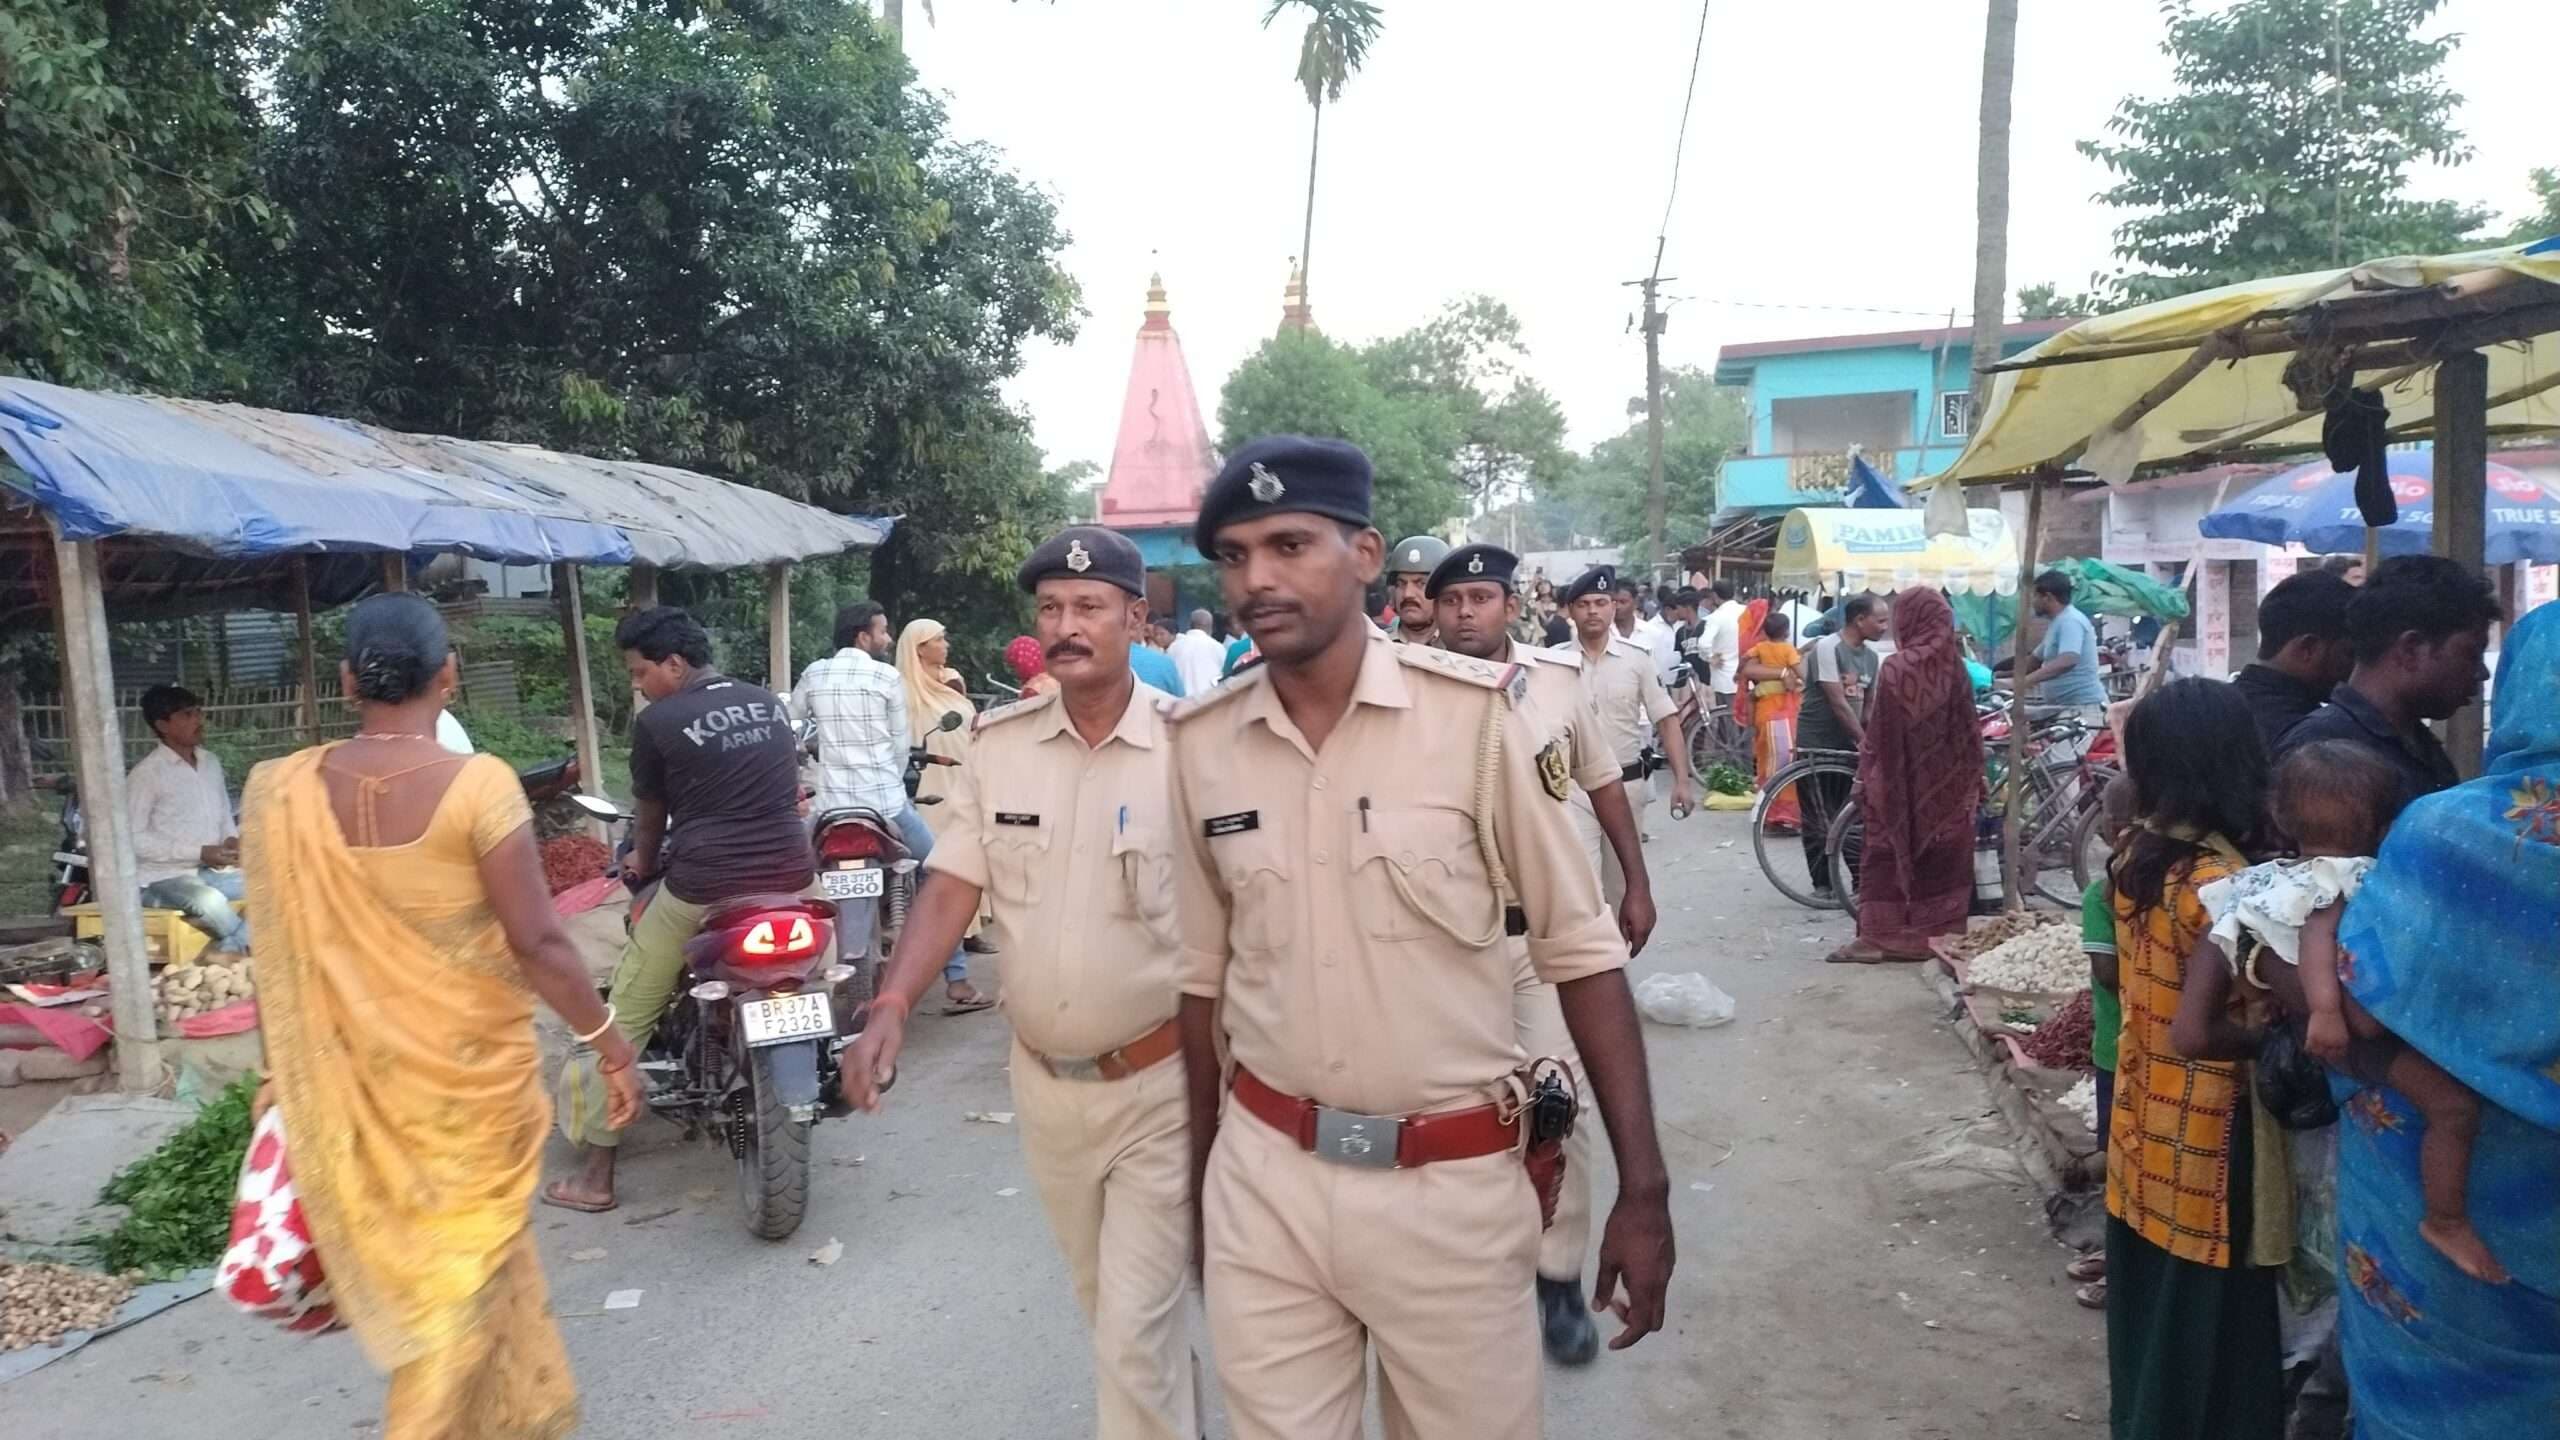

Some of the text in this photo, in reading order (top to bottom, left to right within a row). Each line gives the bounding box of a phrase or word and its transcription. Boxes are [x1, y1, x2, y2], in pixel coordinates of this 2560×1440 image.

[2491, 508, 2545, 524] TRUE
[682, 702, 790, 747] KOREA
[721, 726, 772, 753] ARMY
[828, 881, 879, 897] 5560
[764, 1013, 823, 1034] F2326
